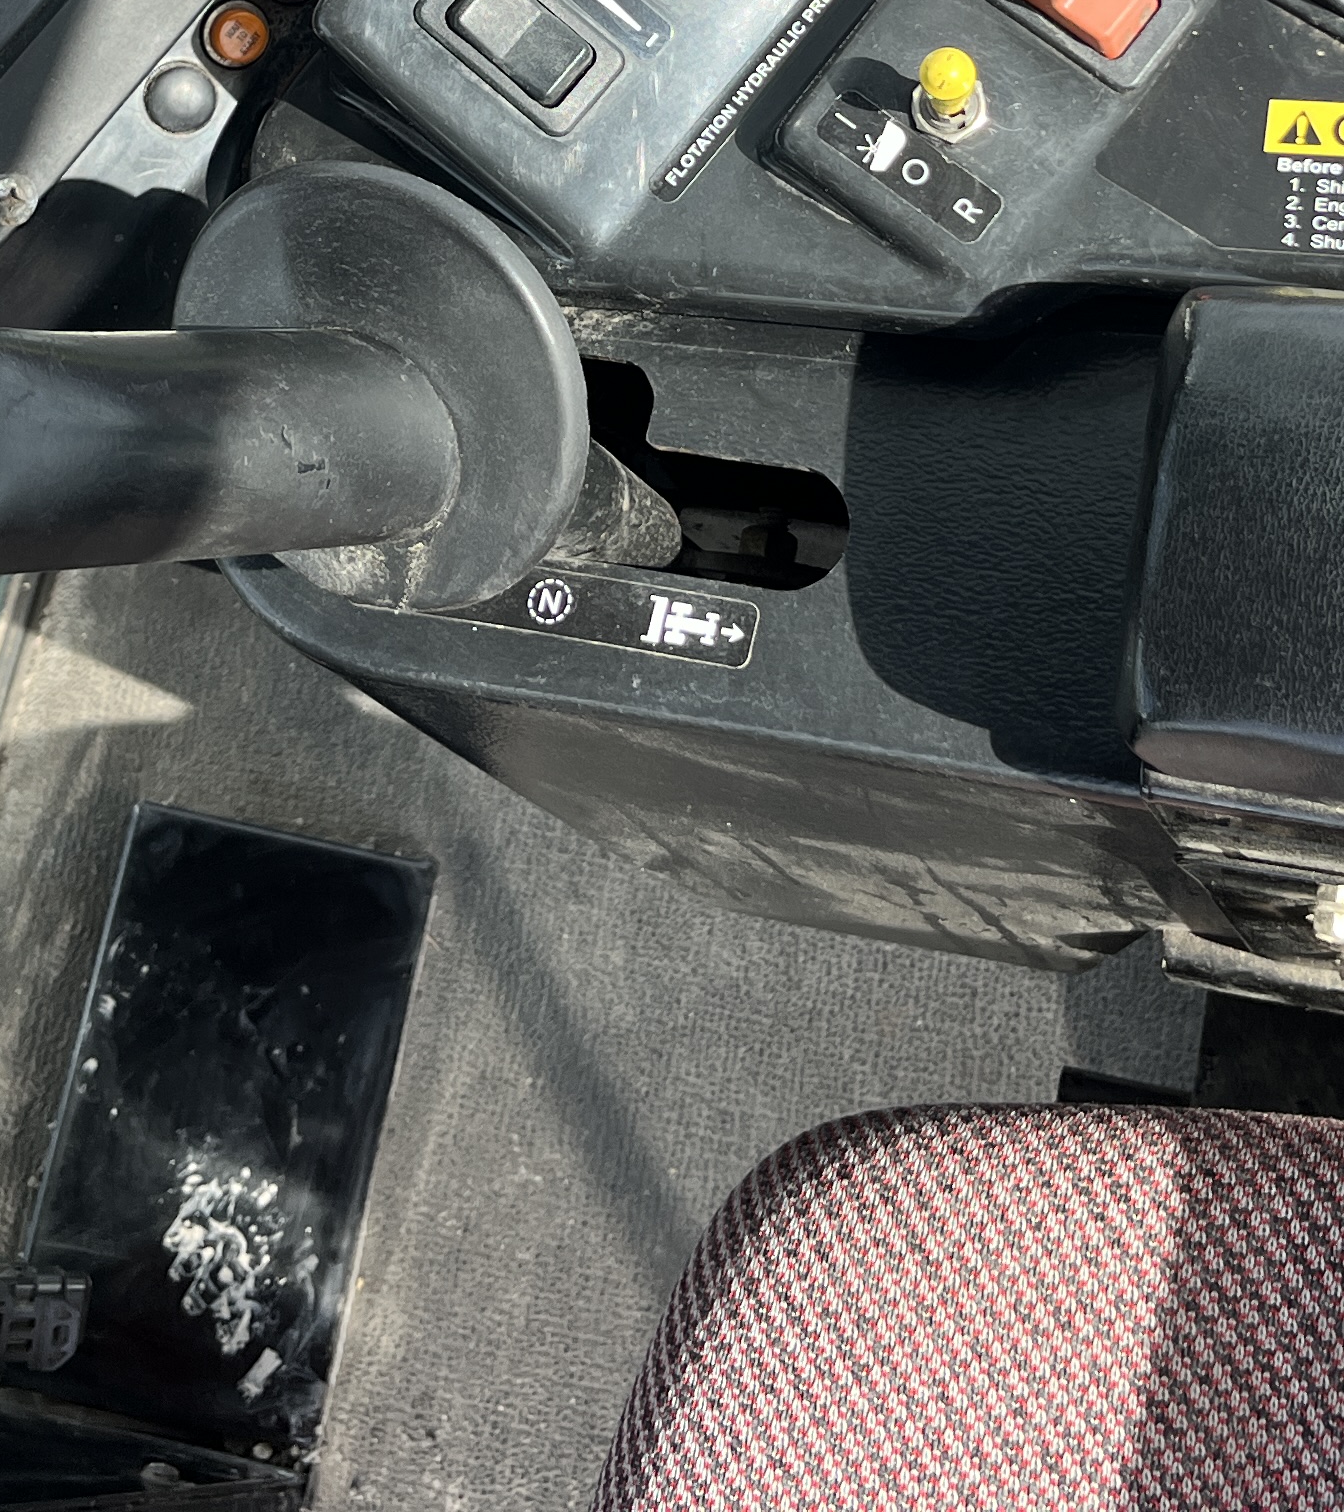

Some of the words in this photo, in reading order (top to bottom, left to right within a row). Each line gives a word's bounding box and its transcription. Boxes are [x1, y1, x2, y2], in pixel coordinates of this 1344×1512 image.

[664, 105, 738, 187] FLOTATION
[731, 20, 807, 106] HYDRAULIC
[1276, 156, 1343, 177] Before
[1289, 177, 1306, 193] 1.
[952, 197, 983, 225] R
[1285, 195, 1303, 211] 2.
[1282, 214, 1301, 230] 3.
[1280, 231, 1300, 248] 4.
[537, 587, 564, 616] N
